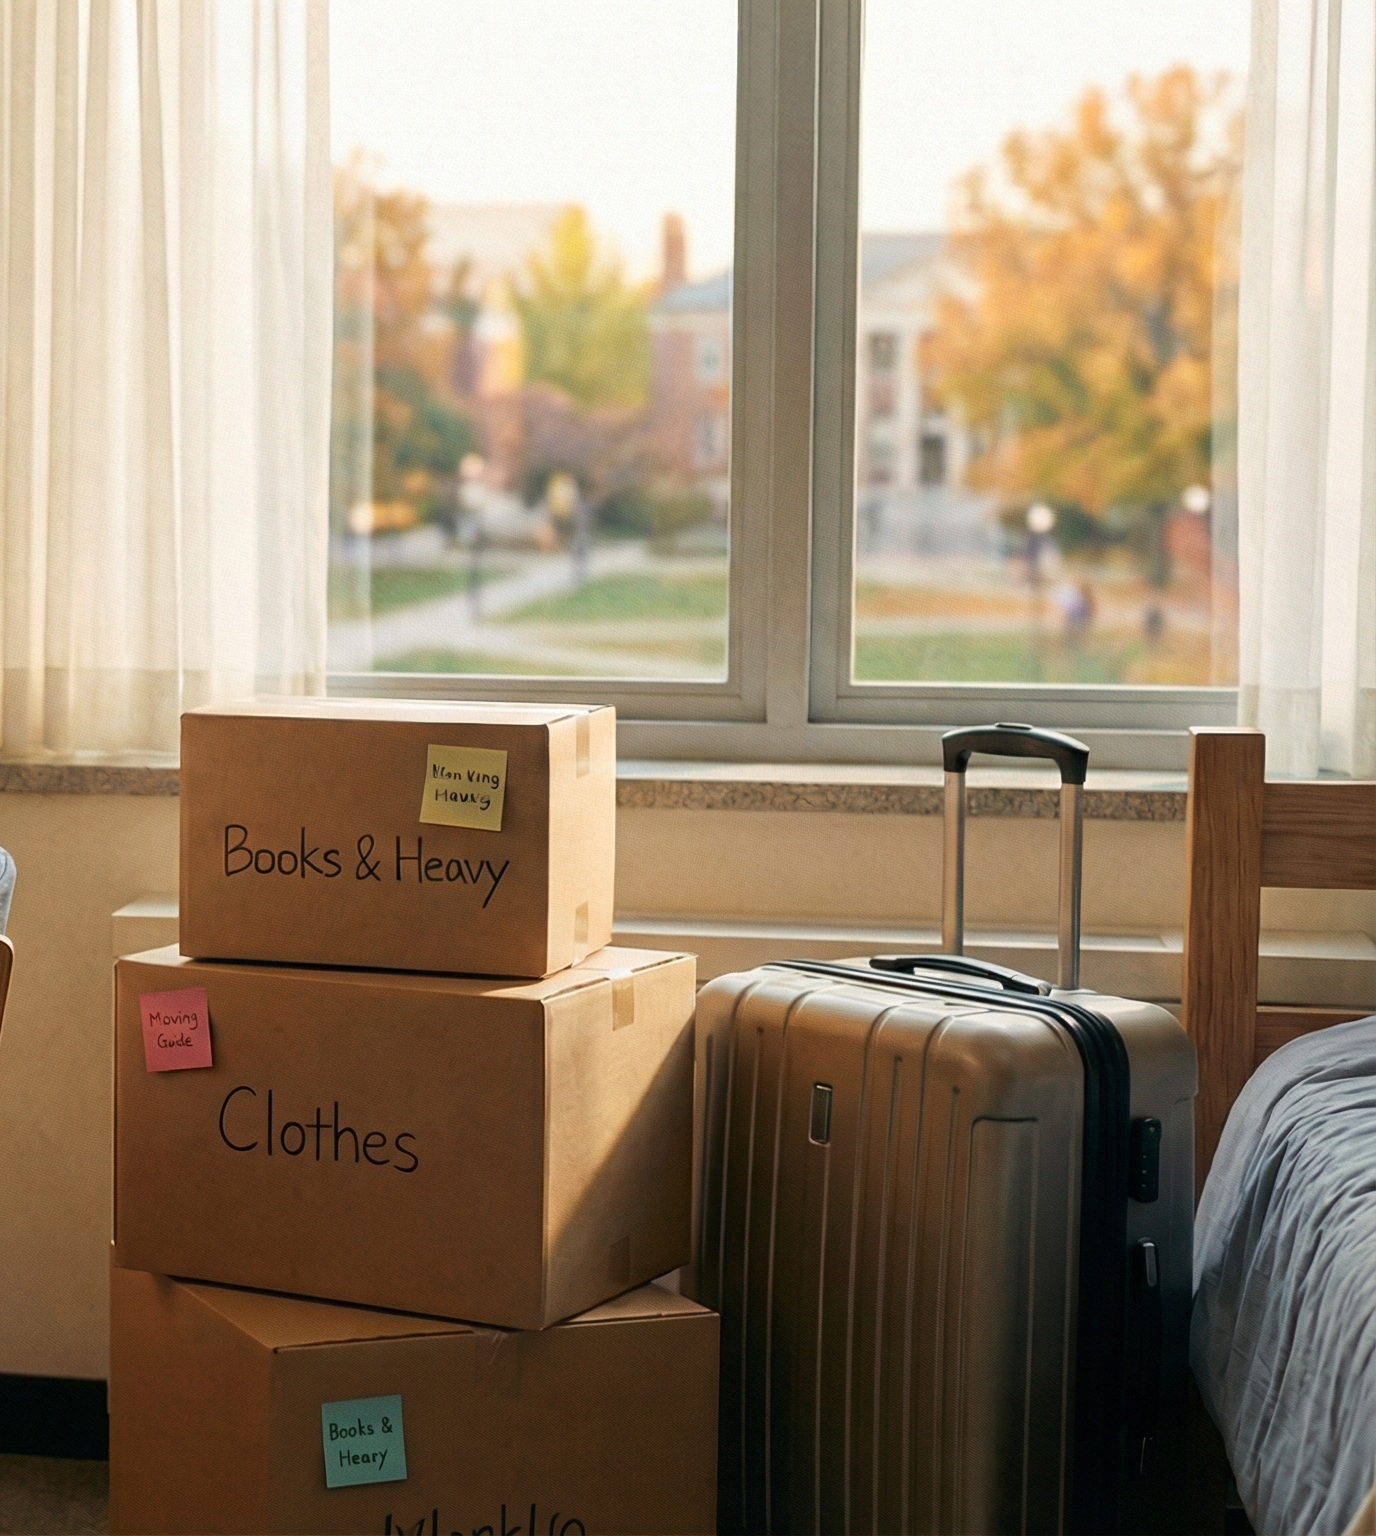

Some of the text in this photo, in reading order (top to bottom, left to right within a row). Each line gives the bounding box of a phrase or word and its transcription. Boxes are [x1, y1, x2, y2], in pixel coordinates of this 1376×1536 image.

[224, 824, 511, 908] Books & Heavy
[149, 1012, 198, 1030] Moving
[157, 1032, 194, 1049] Guide
[219, 1085, 420, 1174] Clothes
[329, 1416, 393, 1441] Books &
[339, 1448, 388, 1471] Heary
